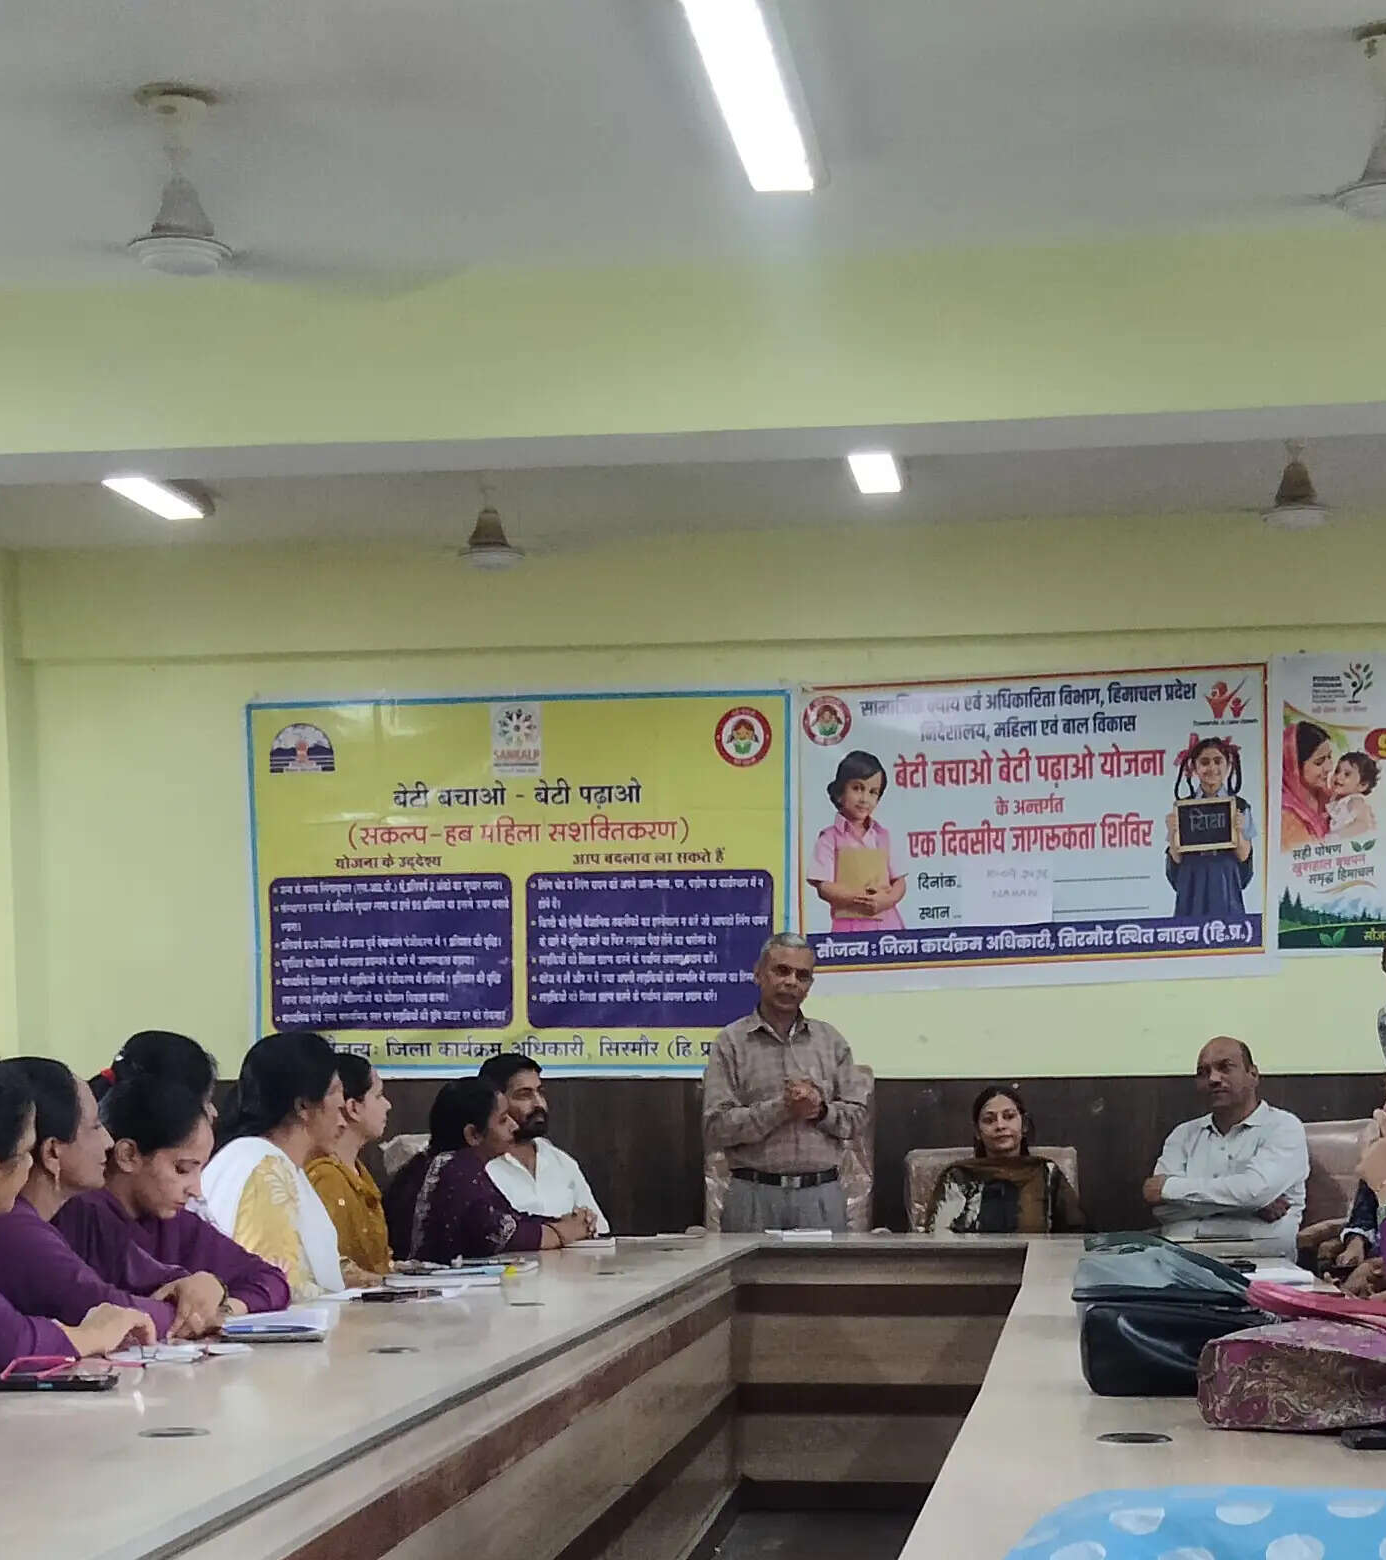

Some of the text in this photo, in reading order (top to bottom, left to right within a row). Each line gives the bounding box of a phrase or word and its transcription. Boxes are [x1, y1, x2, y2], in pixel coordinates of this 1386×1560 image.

[964, 690, 981, 711] एवं
[985, 686, 1056, 711] अधिकारिता
[1060, 684, 1104, 707] विभाग,
[1107, 681, 1161, 704] हिमाचल
[1164, 678, 1197, 701] प्रदेश
[994, 716, 1037, 739] महिला
[1041, 714, 1058, 736] एवं
[1062, 717, 1089, 734] बाल
[1093, 712, 1137, 733] विकास
[894, 743, 1165, 788] बेटी बचाओ बेटी पढ़ाओ योजना
[393, 781, 429, 808] बेटी
[438, 780, 506, 807] बचाओ
[534, 778, 570, 805] बेटी
[579, 777, 641, 809] पढ़ाओ
[995, 793, 1065, 816] के अन्तर्गत
[908, 811, 1154, 858] एक दिवसीय जागरूकता शिविर
[334, 853, 378, 869] योजना
[382, 853, 394, 868] के
[573, 852, 600, 865] आप
[604, 851, 650, 865] बदलाव
[654, 852, 672, 864] ला
[677, 849, 710, 865] सकते
[918, 905, 950, 920] स्थान
[879, 935, 918, 956] जिला
[921, 932, 983, 954] कार्यक्रम
[1058, 925, 1113, 948] सिरमौर
[1116, 923, 1154, 945] स्थित
[1157, 926, 1199, 944] नाहन
[385, 1037, 432, 1057] जिला
[438, 1035, 503, 1057] कार्यक्रम
[599, 1034, 658, 1057] सिरमौर
